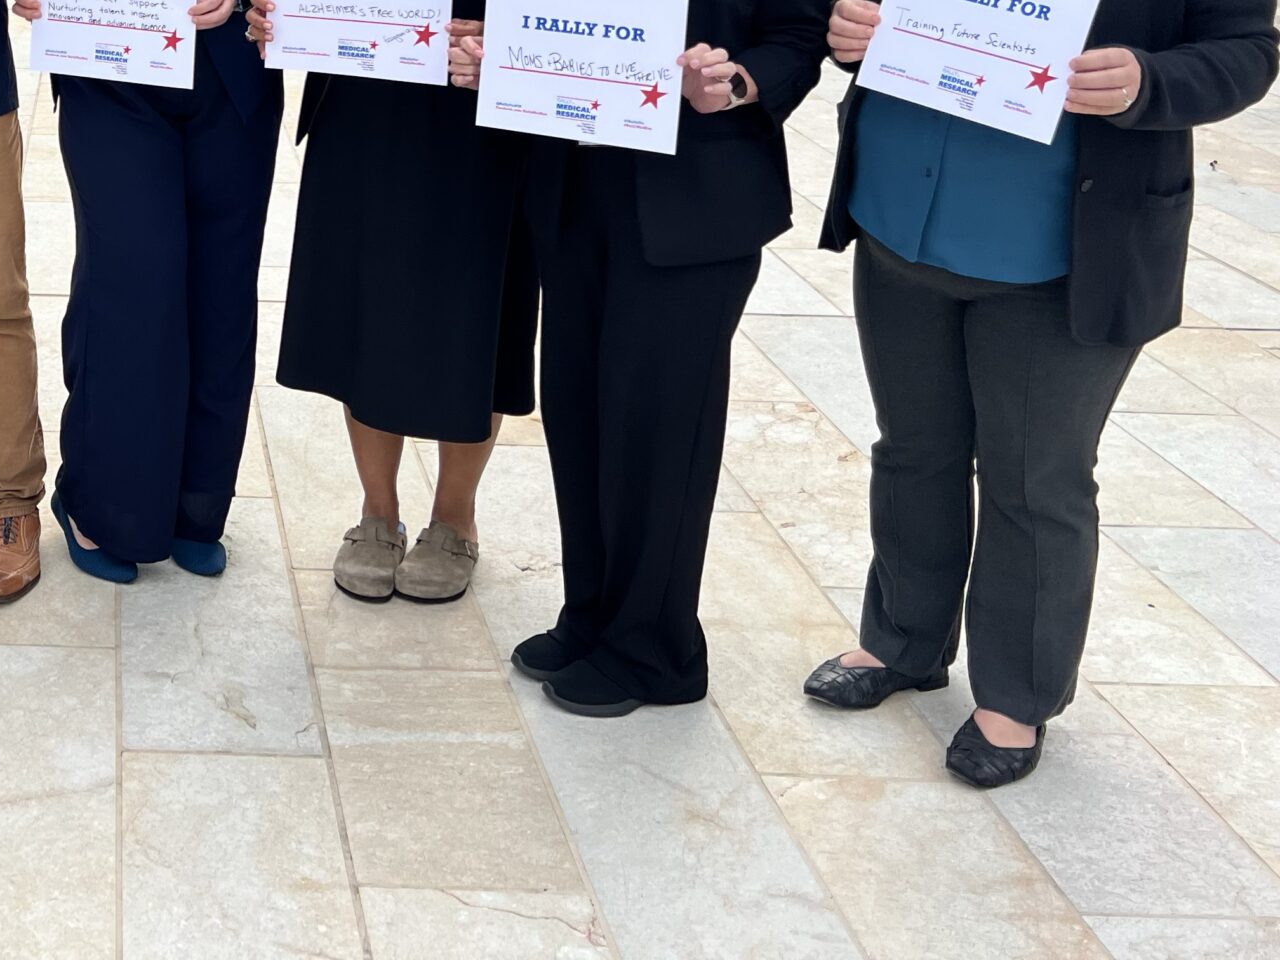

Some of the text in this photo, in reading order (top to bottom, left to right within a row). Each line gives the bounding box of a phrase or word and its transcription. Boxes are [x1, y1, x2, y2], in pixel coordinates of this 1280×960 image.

[48, 2, 93, 18] Nurturing
[522, 15, 646, 42] I RALLY FOR
[896, 6, 1037, 56] Training Future Scientists
[95, 49, 124, 57] MEDICAL
[338, 44, 369, 53] MEDICAL
[95, 54, 128, 64] RESEARCH
[338, 50, 375, 59] RESEARCH
[598, 66, 610, 76] TO
[940, 74, 974, 89] MEDICAL
[938, 80, 978, 98] RESEARCH
[556, 103, 590, 114] MEDICAL
[556, 110, 597, 121] RESEARCH
